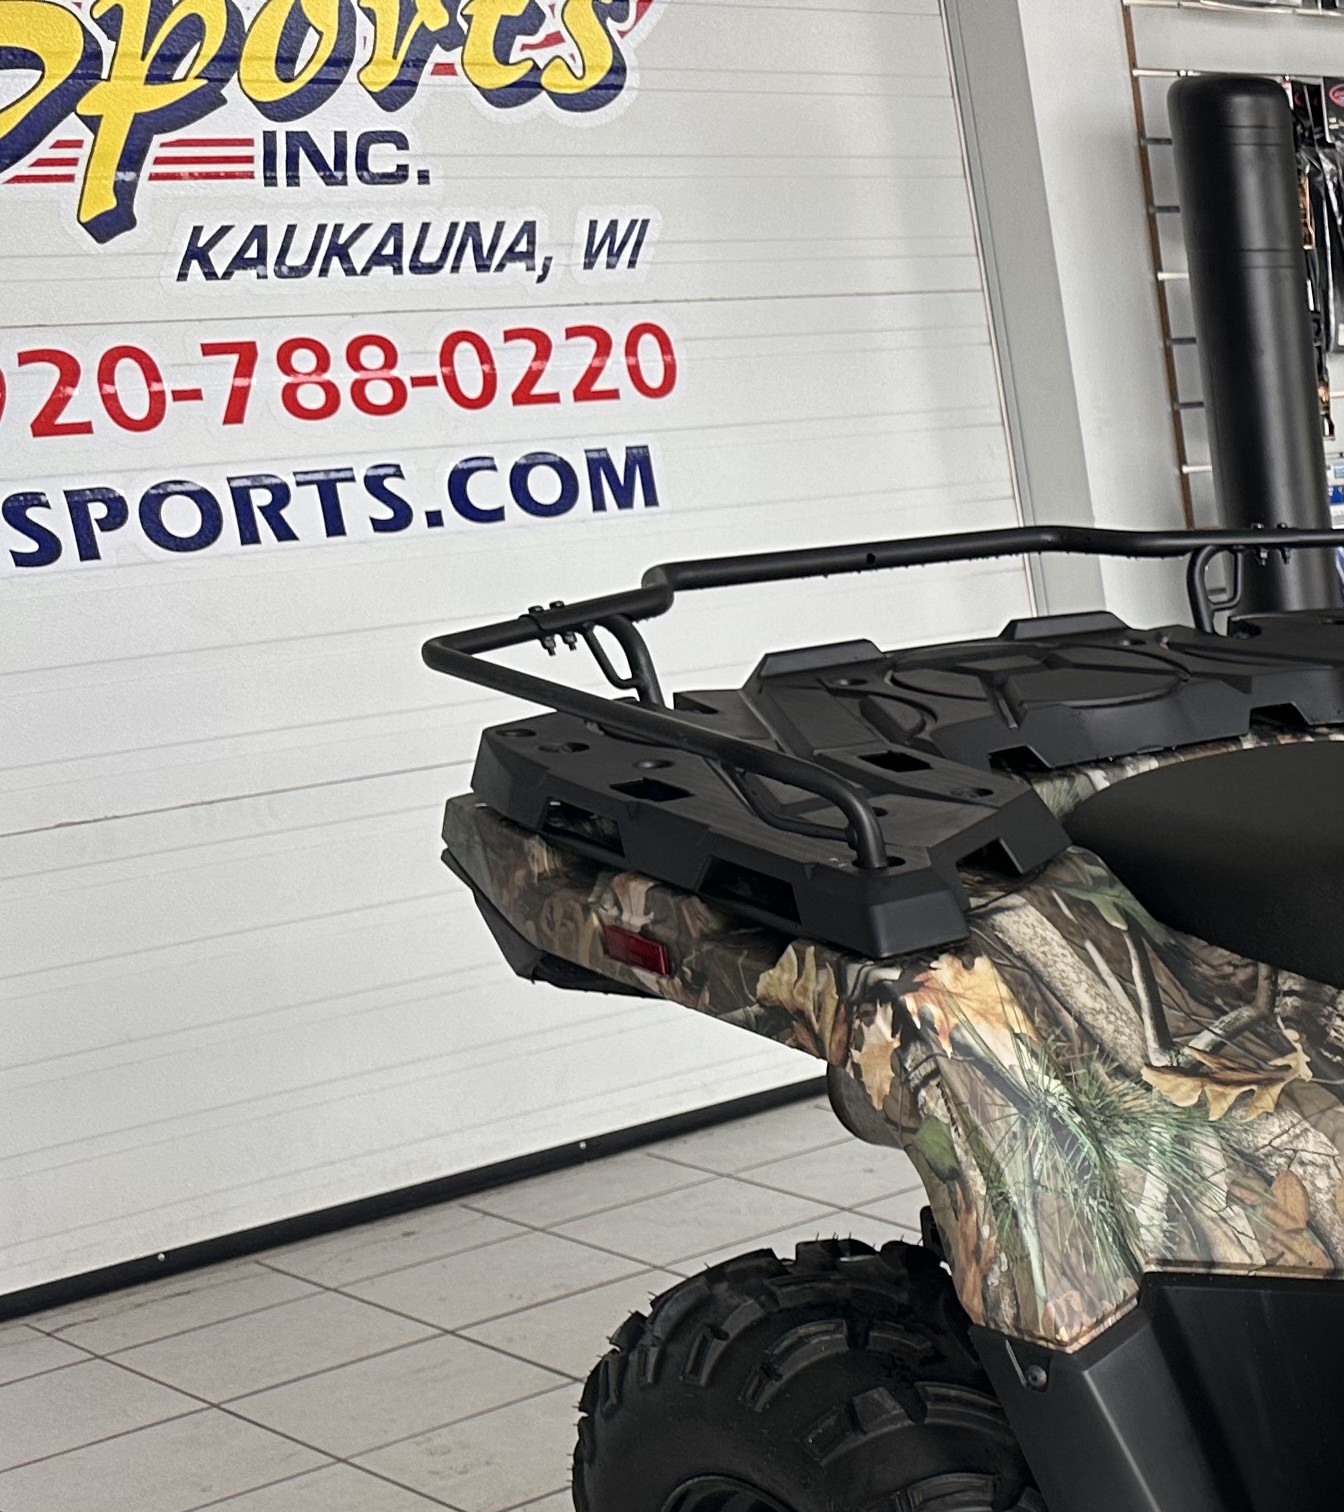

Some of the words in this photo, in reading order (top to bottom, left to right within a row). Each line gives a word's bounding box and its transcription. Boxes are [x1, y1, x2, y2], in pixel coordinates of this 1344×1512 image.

[262, 129, 432, 188] INC.
[176, 221, 554, 284] KAUKAUNA,
[582, 218, 650, 272] WI
[0, 322, 678, 439] 20-788-0220
